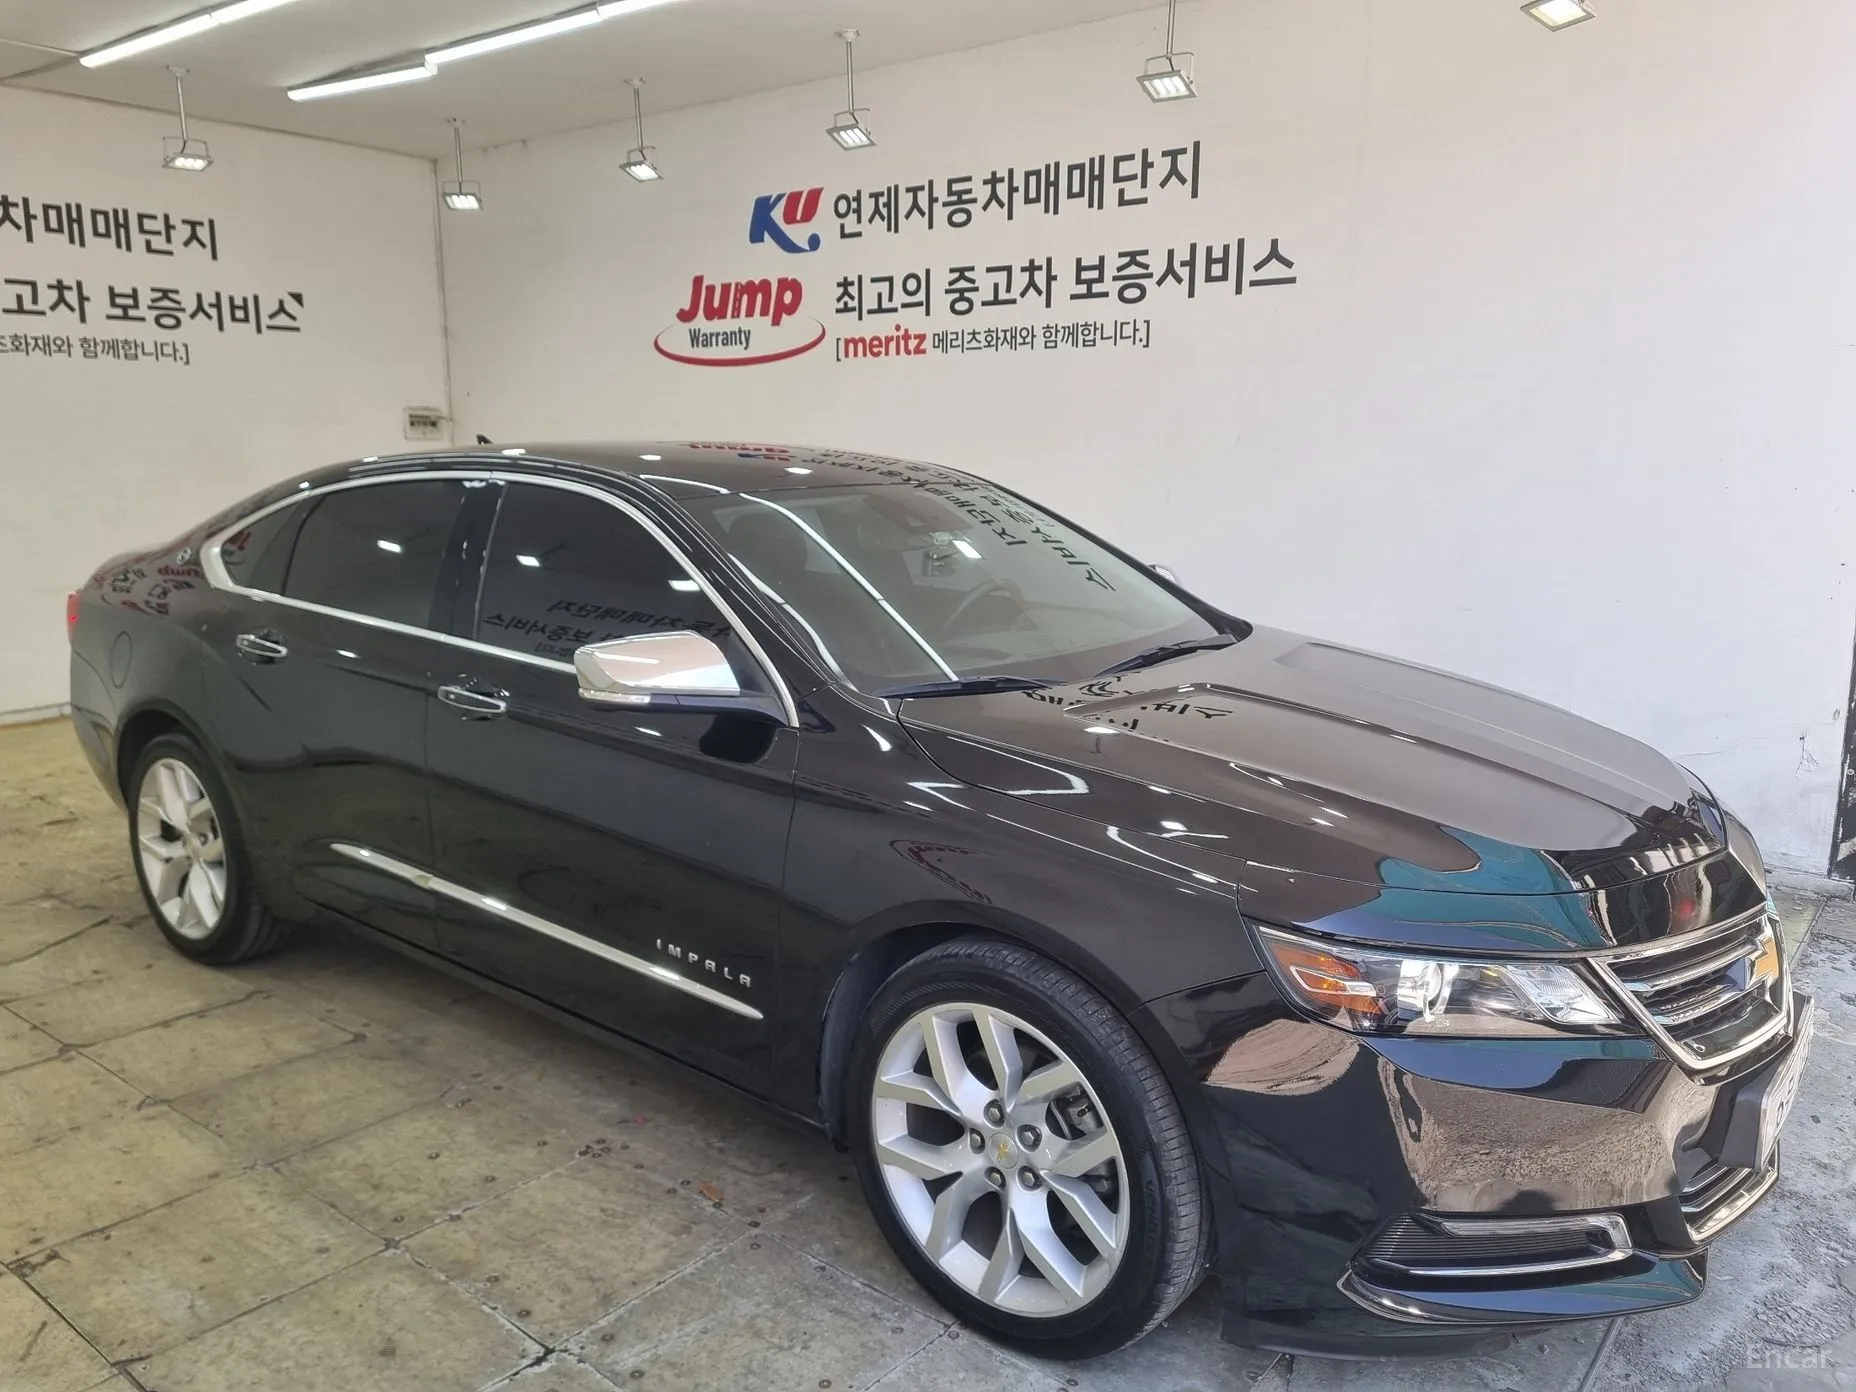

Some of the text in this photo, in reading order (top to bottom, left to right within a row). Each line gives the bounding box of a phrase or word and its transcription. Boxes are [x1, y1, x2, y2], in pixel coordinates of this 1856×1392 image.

[833, 140, 1200, 239] 연제자동차매매단지
[0, 195, 218, 260] 차매매단지
[676, 274, 803, 326] Jump
[835, 237, 1297, 321] 최고의 중고차 보증서비스
[105, 284, 302, 334] 보증서비스
[689, 326, 751, 350] Warranty
[932, 324, 1036, 354] 메리츠화재와
[1042, 319, 1150, 349] 함께합니다.]
[656, 938, 751, 988] IMPALA
